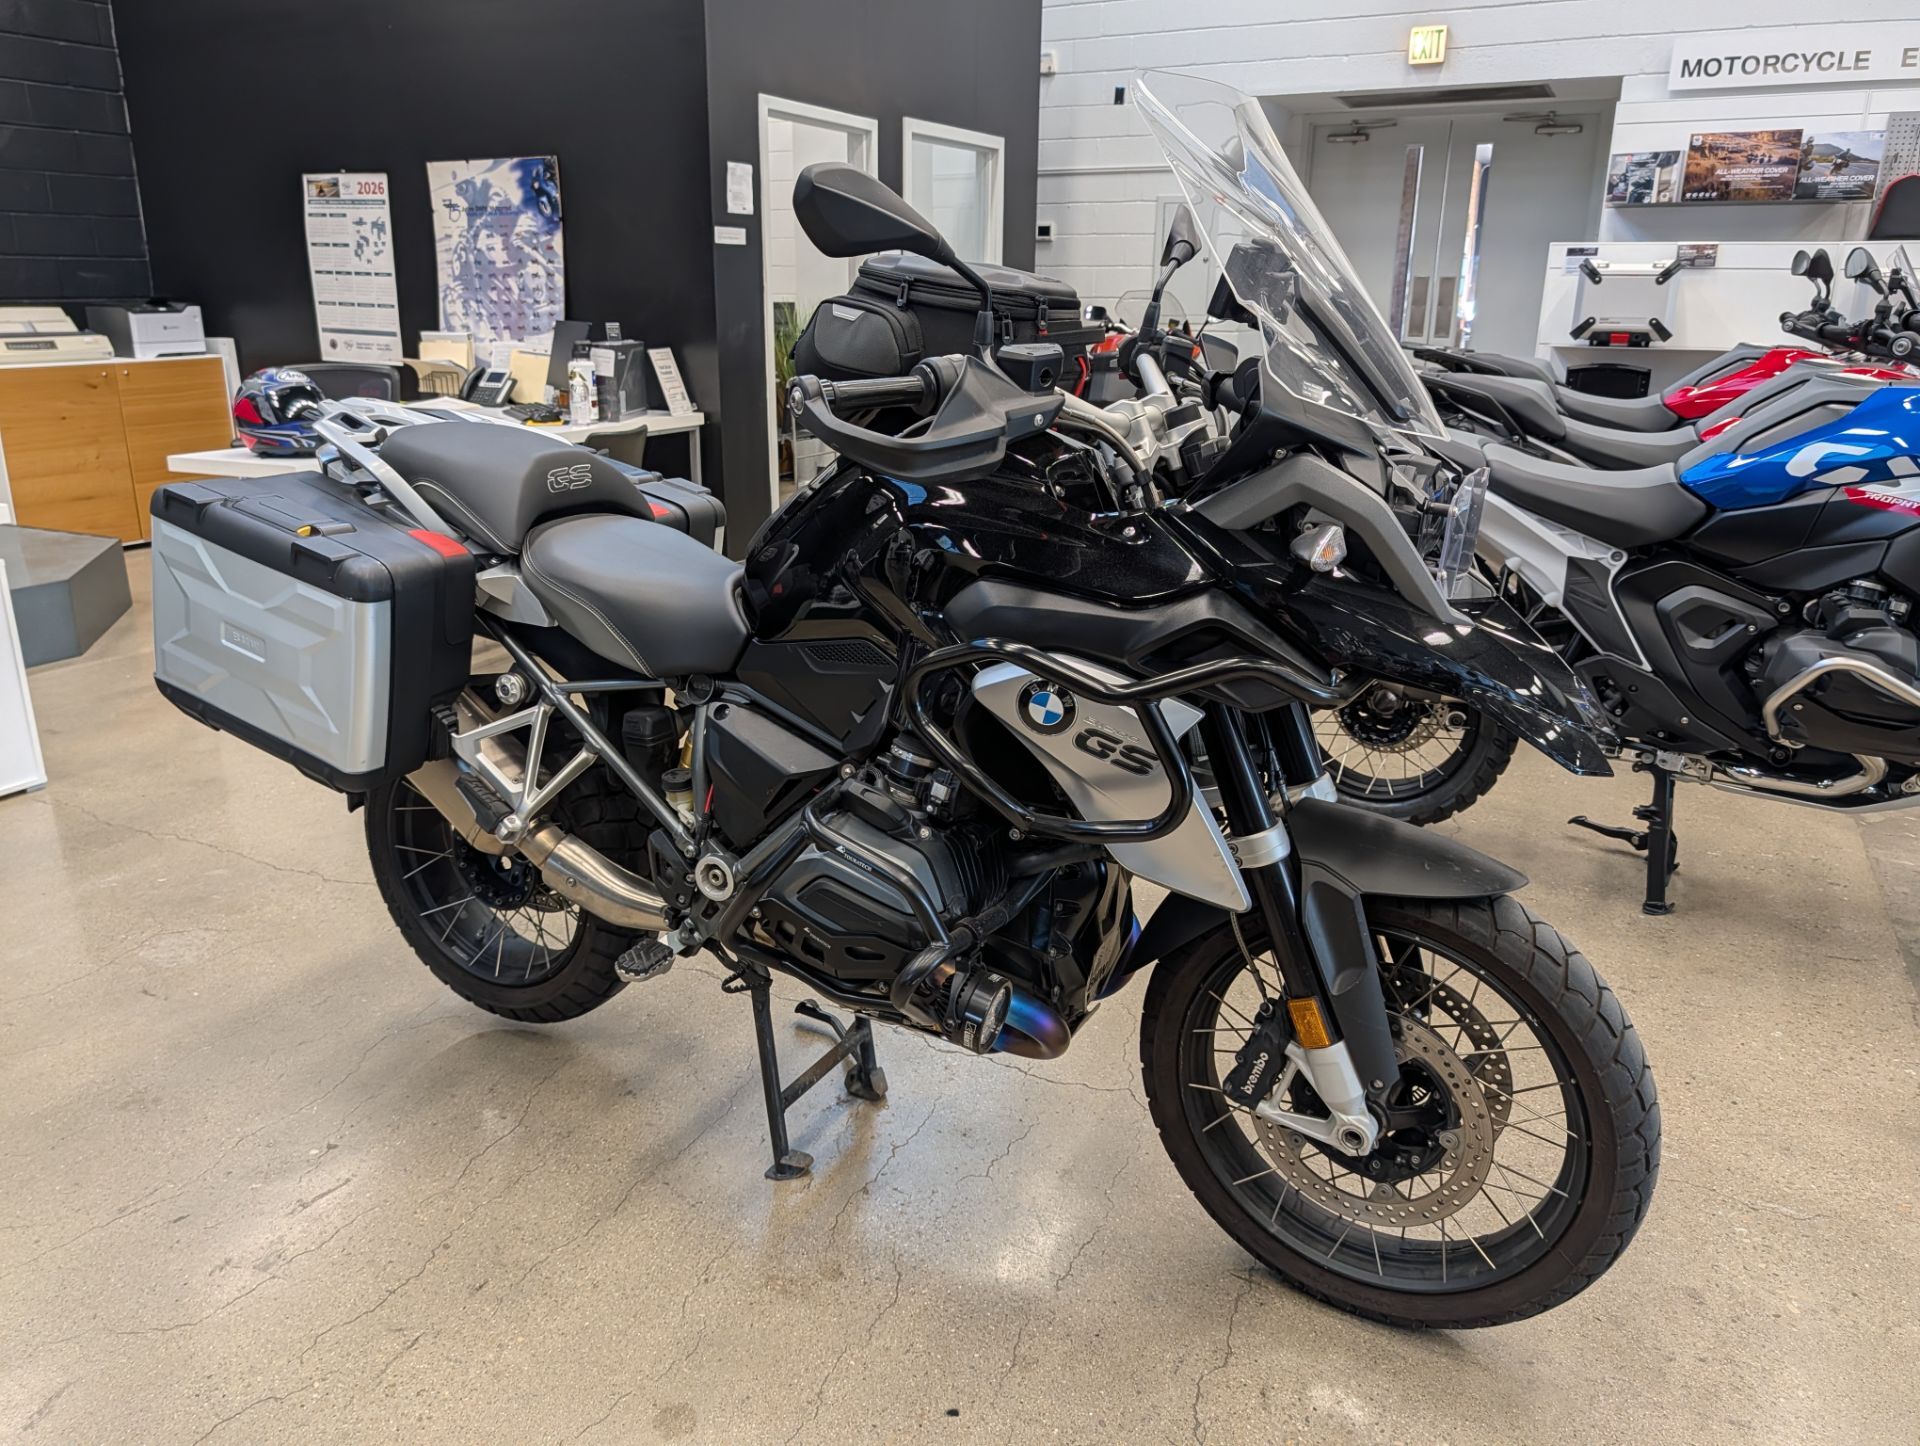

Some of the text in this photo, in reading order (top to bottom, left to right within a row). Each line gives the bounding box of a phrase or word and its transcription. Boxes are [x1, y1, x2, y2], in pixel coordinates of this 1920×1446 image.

[1411, 29, 1444, 60] EXIT
[1680, 50, 1872, 78] MOTORCYCLE
[357, 181, 385, 195] 2026
[1799, 174, 1874, 183] ALL-WEATHER COVER
[547, 464, 592, 493] GS
[1863, 491, 1920, 509] TROPHY
[1030, 682, 1073, 707] BMW
[1071, 727, 1160, 777] GS
[1240, 1052, 1269, 1095] brembo
